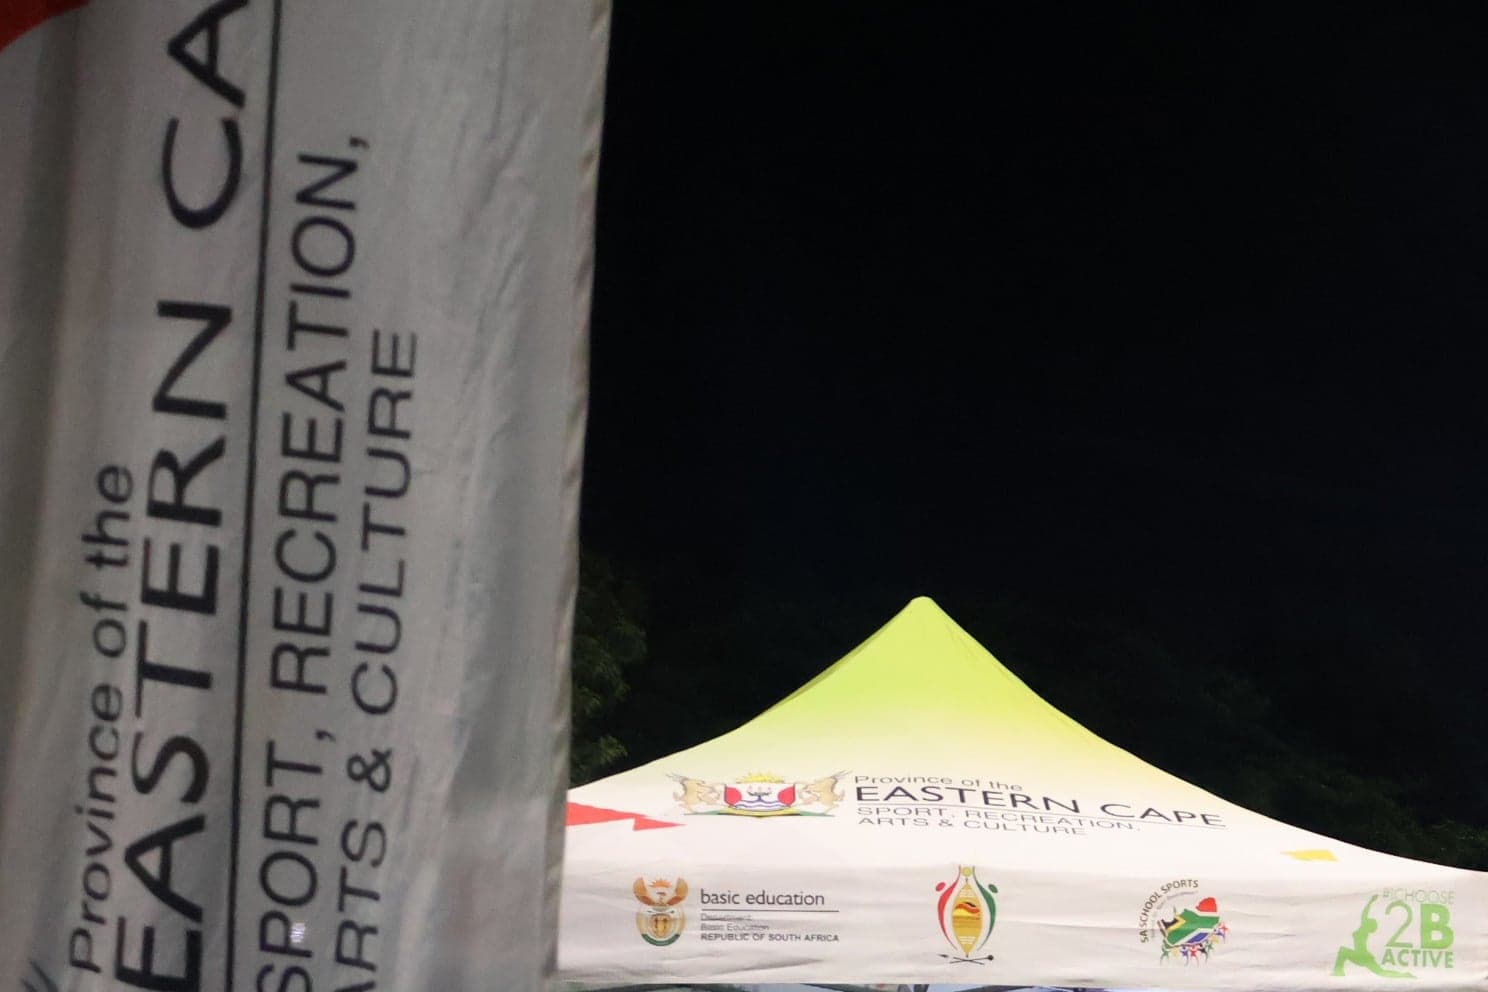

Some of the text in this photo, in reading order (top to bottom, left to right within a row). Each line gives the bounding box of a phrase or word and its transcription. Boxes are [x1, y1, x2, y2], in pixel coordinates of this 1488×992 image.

[270, 136, 369, 695] RECREATION,
[351, 329, 418, 715] CULTURE
[69, 465, 134, 975] Province of the
[347, 749, 393, 793] &
[855, 775, 1023, 791] Province of the
[856, 786, 1226, 828] EASTERN CAPE
[858, 817, 1087, 836] ARTS & CULTURE
[1161, 879, 1199, 894] SPORTS
[700, 888, 825, 906] basic education
[700, 933, 840, 942] REPUBLIC OF SOUTH AFRICA
[1381, 948, 1454, 968] ACTIVE
